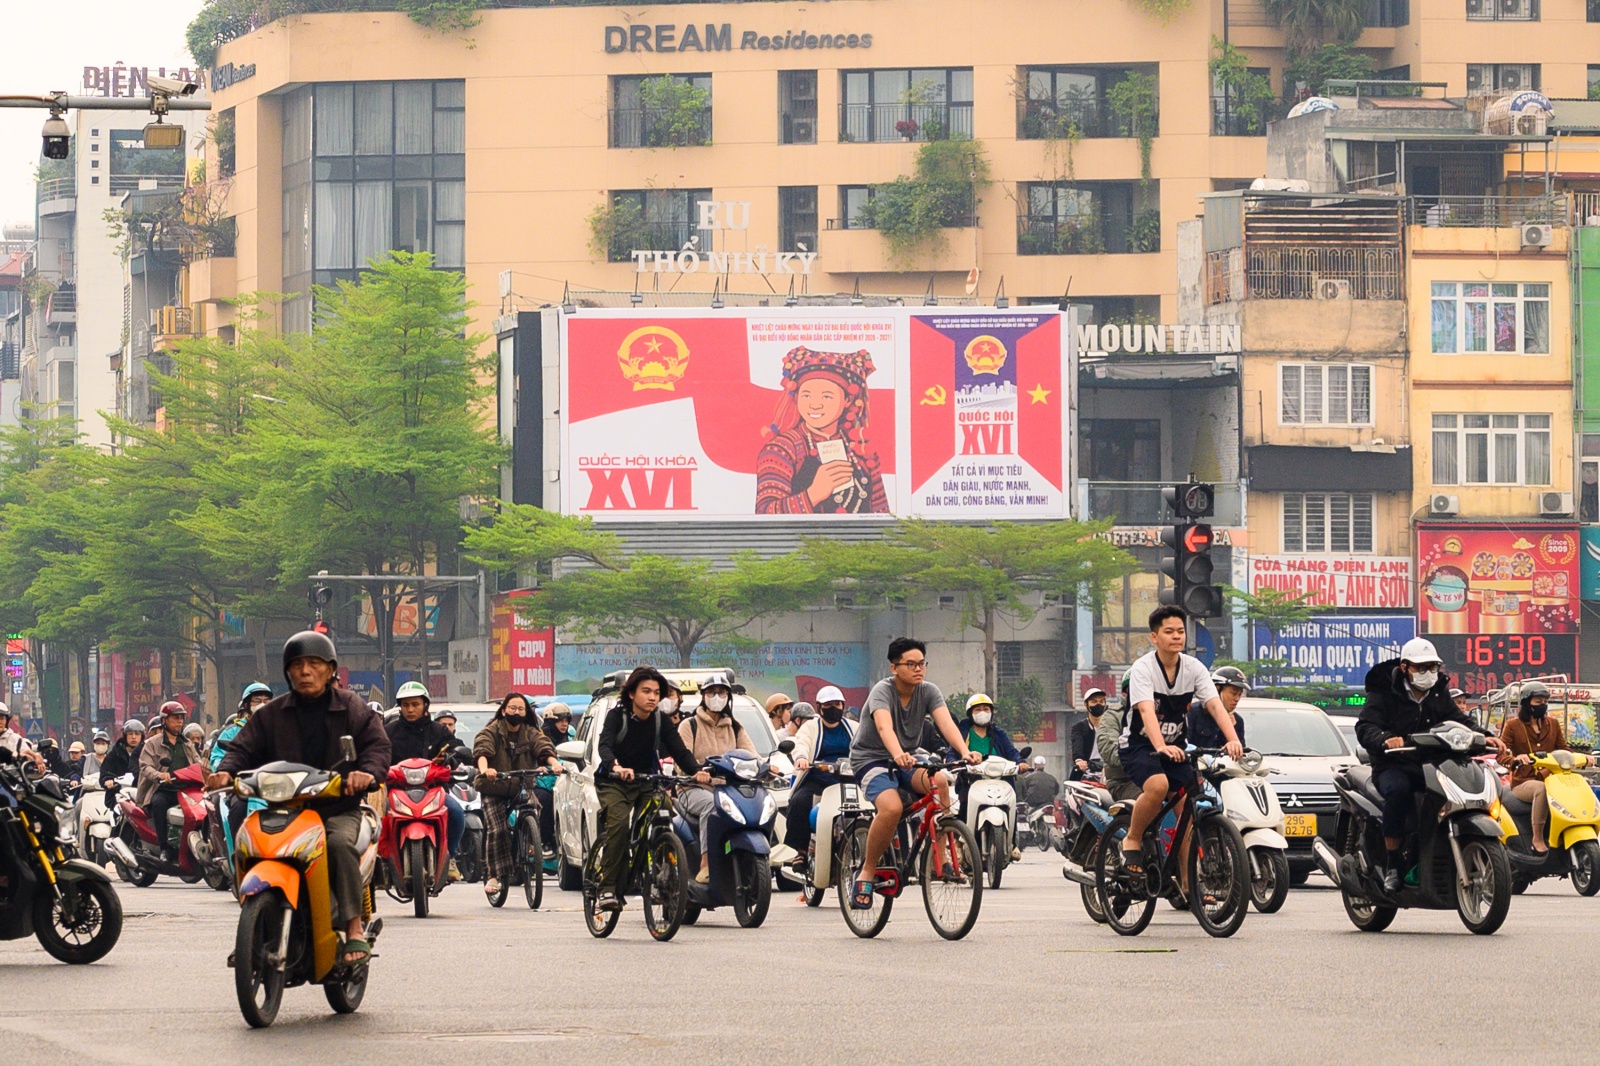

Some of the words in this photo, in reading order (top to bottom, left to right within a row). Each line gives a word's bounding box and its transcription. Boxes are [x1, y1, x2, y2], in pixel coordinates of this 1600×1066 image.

[604, 23, 732, 54] DREAM
[740, 30, 873, 50] Residences
[697, 200, 752, 231] EU
[631, 235, 700, 273] THỔ
[774, 242, 817, 274] KỲ
[1077, 324, 1241, 353] MOUNTAIN
[958, 410, 990, 422] QUỐC
[994, 410, 1014, 423] HỘI
[958, 424, 1014, 456] XVI
[579, 452, 621, 466] QUỐC
[625, 454, 650, 468] HỘI
[655, 453, 698, 466] KHÓA
[951, 463, 965, 477] TẤT
[966, 462, 977, 476] CẢ
[979, 464, 986, 476] VÌ
[988, 465, 1004, 478] MỤC
[1006, 464, 1022, 476] TIÊU
[579, 468, 699, 511] XVI
[943, 479, 959, 492] DÂN
[983, 477, 1004, 492] NƯỚC
[926, 494, 942, 506] DÂN
[962, 494, 983, 506] CÔNG
[1009, 493, 1024, 506] VĂN
[1026, 496, 1049, 506] MINH!
[1213, 530, 1233, 546] EA
[1548, 545, 1568, 553] 2009
[1254, 556, 1282, 571] CỬA
[1287, 557, 1328, 572] HÀNG
[1306, 574, 1338, 606] NGA
[1280, 621, 1320, 638] CHUYÊN
[1325, 623, 1350, 638] KINH
[1354, 623, 1390, 638] DOANH
[518, 640, 546, 658] COPY
[1291, 645, 1323, 672] LOẠI
[1326, 645, 1363, 672] QUẠT
[1365, 645, 1375, 667] 4
[1378, 640, 1404, 665] MÙ
[1465, 635, 1546, 665] 16:30
[513, 668, 525, 686] IN
[527, 665, 552, 686] MÀU
[1286, 815, 1305, 826] 29G
[1285, 826, 1313, 836] 02.76
